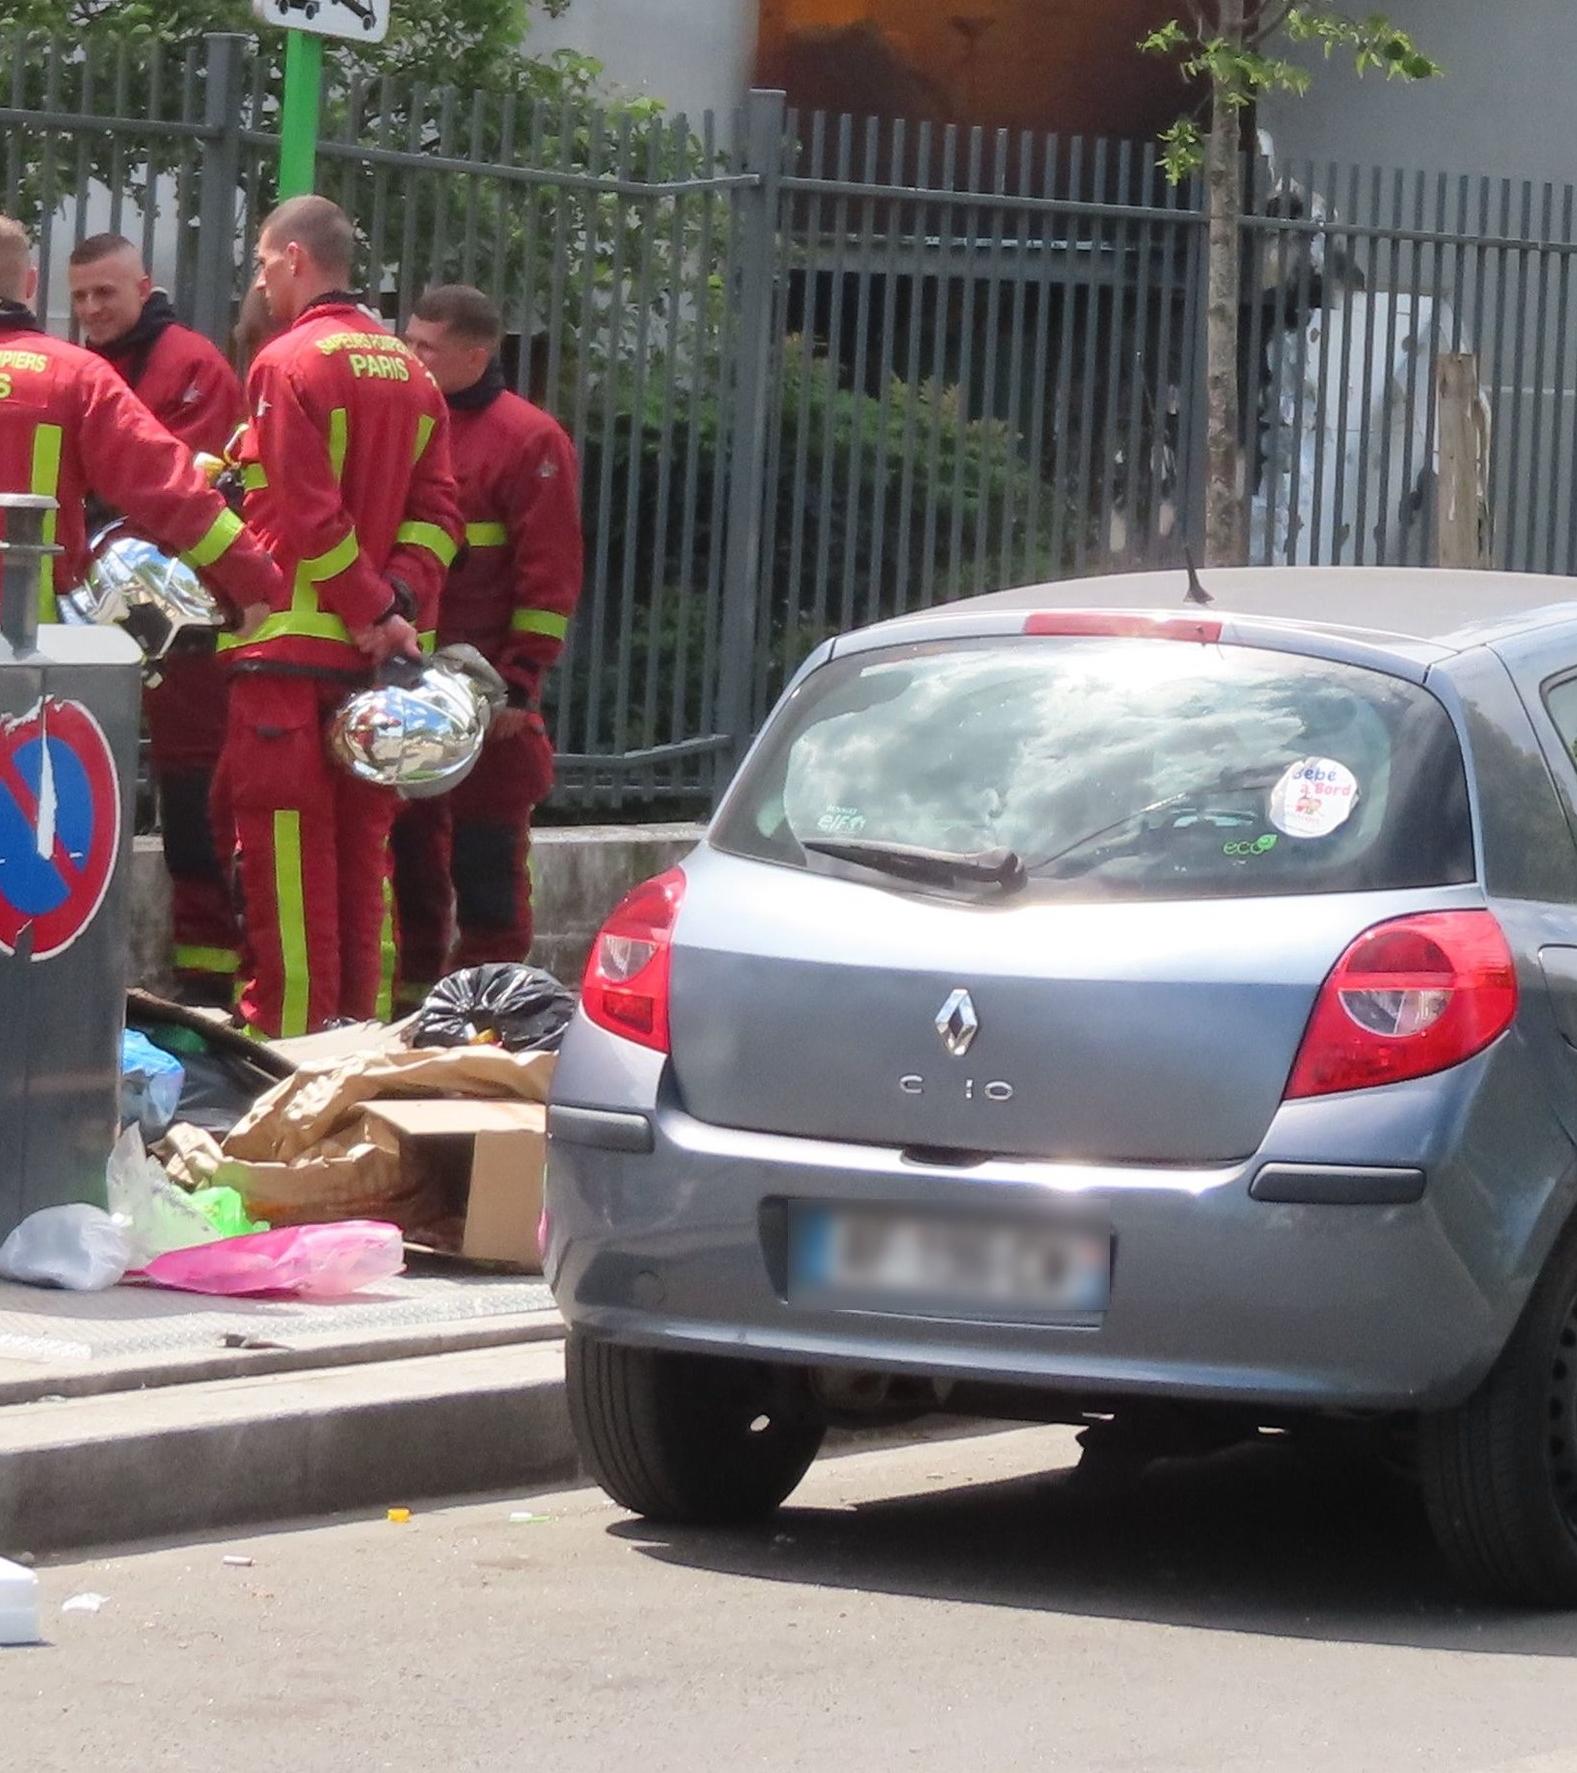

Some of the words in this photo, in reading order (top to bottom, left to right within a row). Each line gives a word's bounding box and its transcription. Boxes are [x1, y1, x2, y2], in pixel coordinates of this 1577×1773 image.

[349, 353, 410, 382] PARIS
[1314, 781, 1352, 797] Bord
[1223, 841, 1264, 855] eco
